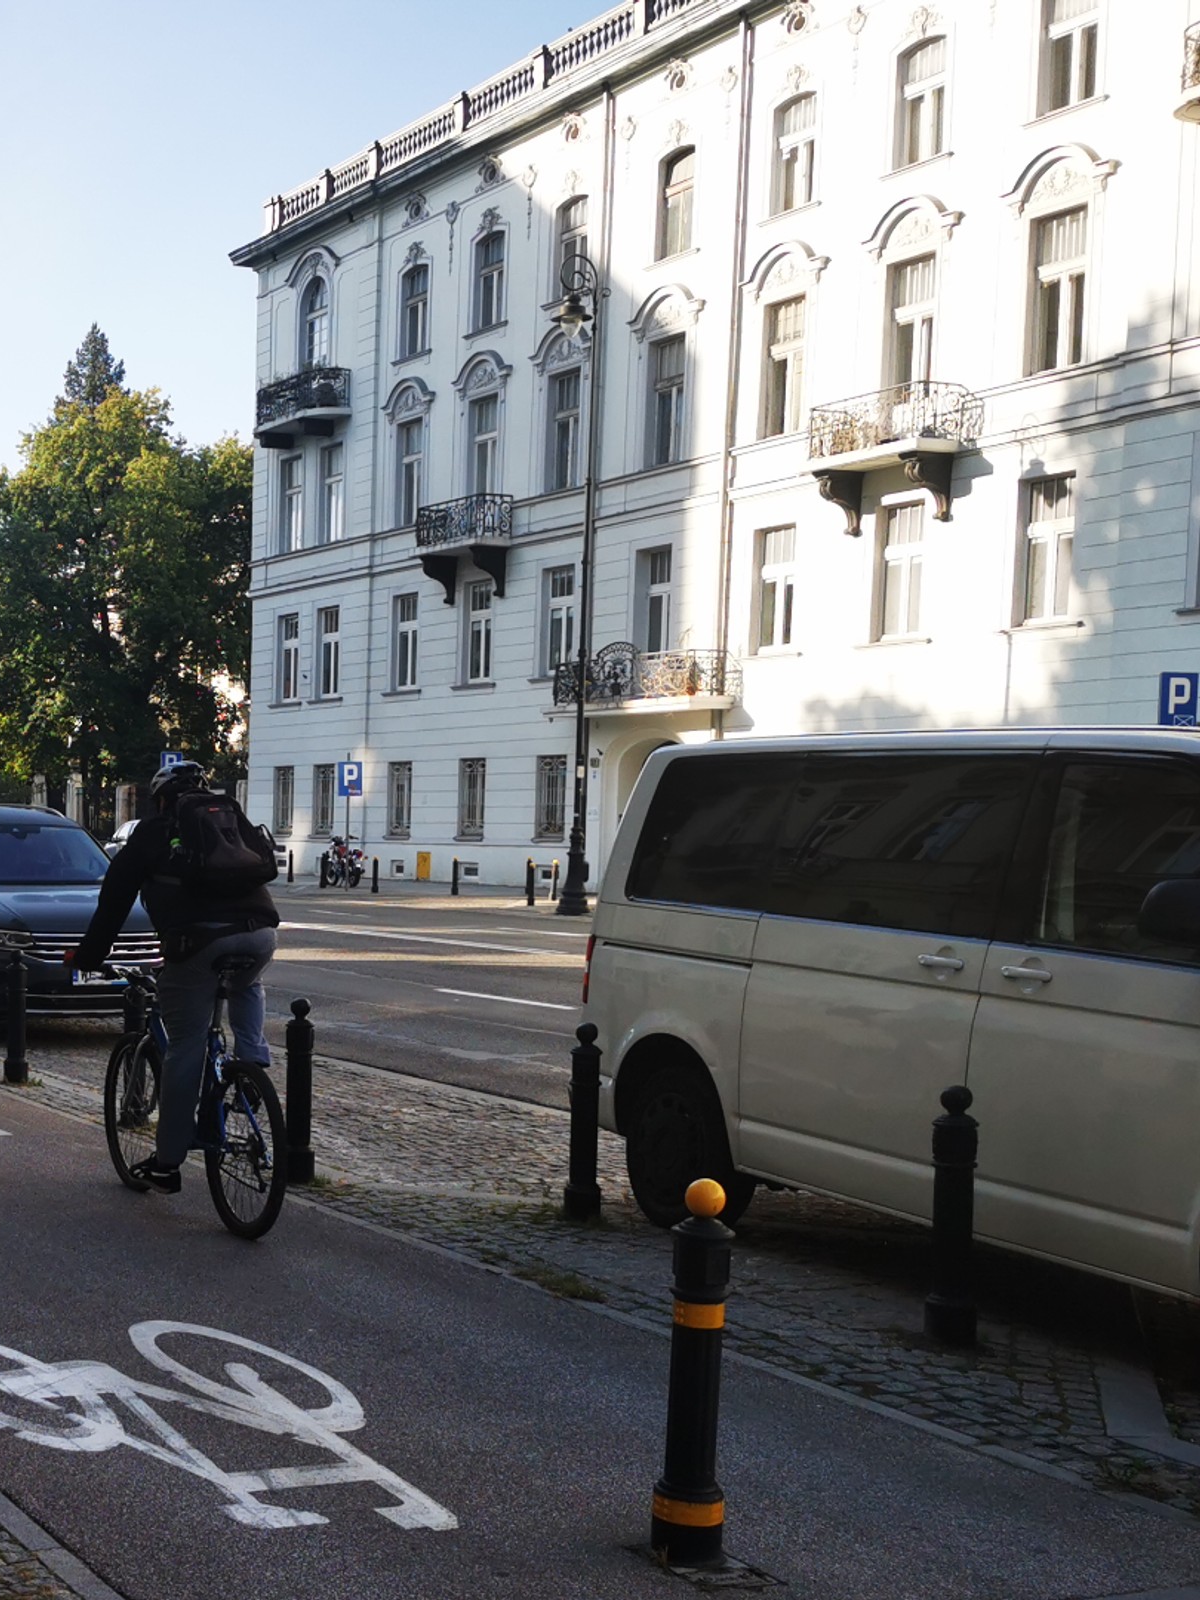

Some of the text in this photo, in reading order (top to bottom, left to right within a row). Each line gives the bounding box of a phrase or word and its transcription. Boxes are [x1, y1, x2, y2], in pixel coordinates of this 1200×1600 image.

[1168, 677, 1191, 714] P
[165, 754, 177, 768] P
[343, 764, 358, 786] P
